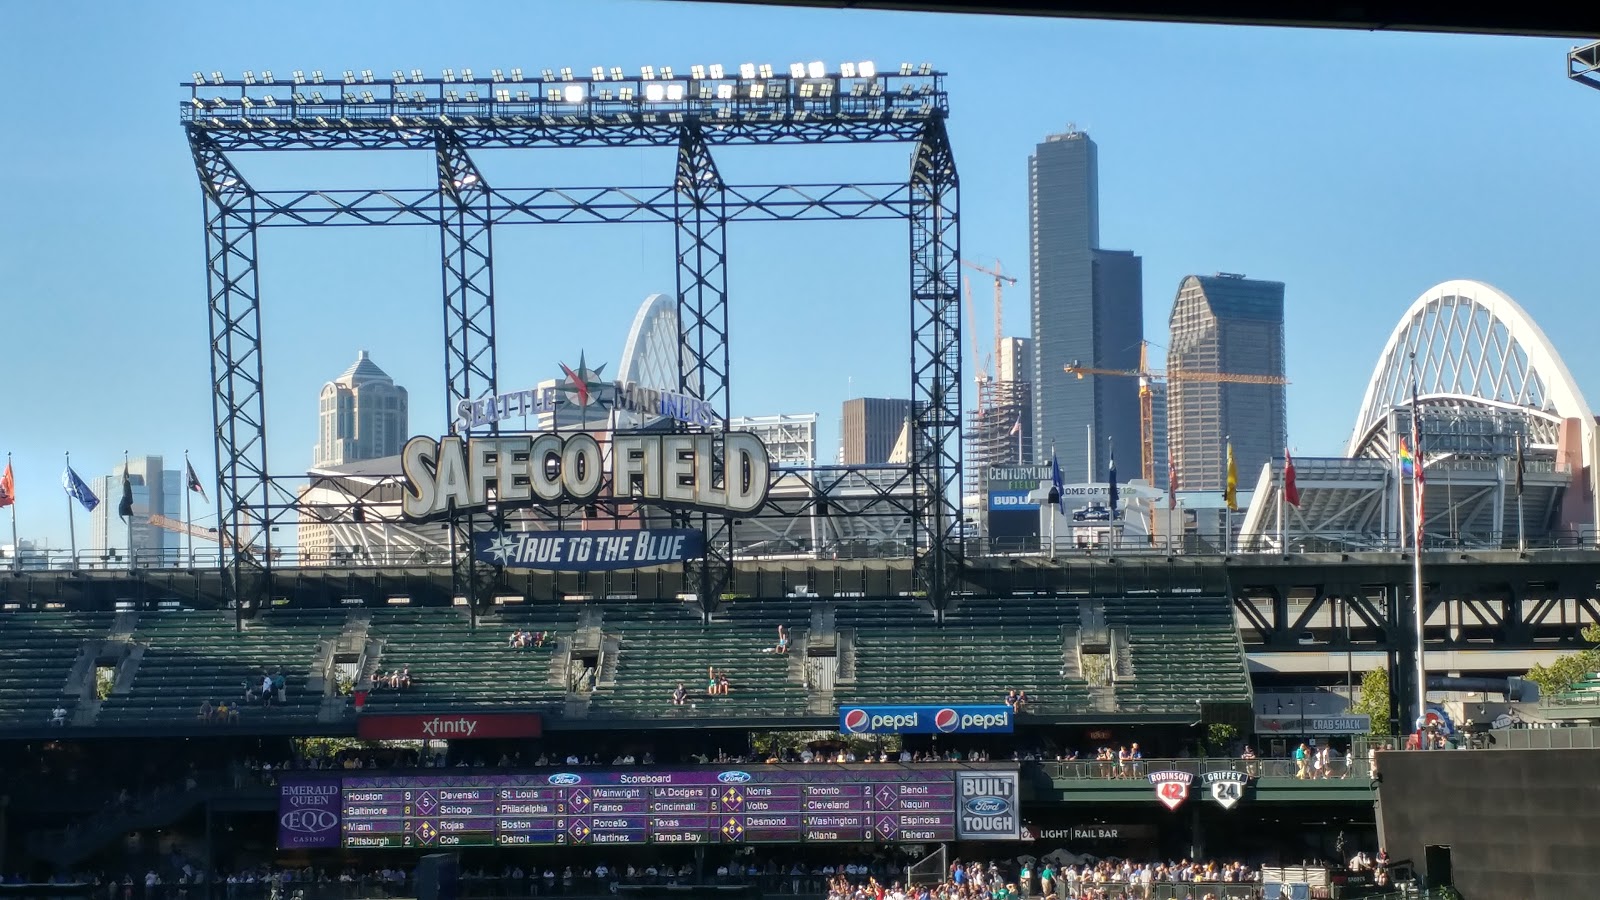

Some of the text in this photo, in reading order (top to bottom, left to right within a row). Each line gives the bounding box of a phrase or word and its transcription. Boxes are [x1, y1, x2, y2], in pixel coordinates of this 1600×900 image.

[456, 380, 713, 433] SEATTLE MARINERS
[402, 432, 770, 522] SAFECO FIELD
[1008, 481, 1036, 490] FIELD
[1088, 487, 1099, 495] OF
[993, 496, 1020, 505] BUD
[515, 531, 685, 562] TRUE TO THE BLUE
[871, 711, 918, 730] pepsi
[961, 711, 1008, 730] pepsi
[1312, 719, 1334, 730] CRAB
[1335, 719, 1360, 730] SHACK
[422, 717, 477, 736] xfinity
[620, 774, 672, 784] Scoreboard
[1151, 772, 1190, 782] ROBINSON
[1207, 772, 1242, 781] GRIFFEY
[282, 785, 338, 796] EMERALD
[746, 787, 772, 796] Norris
[808, 786, 871, 795] Toronto 2
[901, 785, 928, 794] Benoit
[963, 779, 1012, 796] BUILT
[1161, 783, 1184, 799] 42
[1217, 783, 1239, 800] 24
[348, 792, 411, 801] Houston 9
[501, 790, 513, 799] St.
[516, 790, 539, 799] Louis
[593, 788, 640, 798] Wainwright
[654, 788, 717, 798] LA Dodgers 0
[883, 792, 889, 801] 7
[290, 796, 329, 807] QUEEN
[423, 798, 429, 807] 5
[575, 796, 581, 805] 6
[808, 800, 870, 809] Cleveland 1
[901, 800, 930, 809] Naquin
[440, 805, 472, 815] Schoop
[501, 803, 564, 813] Philadelphia 3
[593, 803, 623, 812] Franco
[654, 802, 717, 811] Cincinnati 5
[746, 802, 769, 810] Votto
[974, 800, 1000, 811] Ford
[348, 806, 411, 815] Baltimore 8
[501, 820, 531, 829] Boston
[593, 819, 628, 828] Porcello
[654, 818, 680, 827] Texas
[746, 817, 787, 826] Desmond
[808, 816, 871, 826] Washington 1
[901, 815, 940, 825] Espinosa
[963, 817, 1013, 831] TOUGH
[348, 821, 411, 831] Miami 2
[440, 821, 465, 831] Rojas
[883, 823, 890, 832] 5
[423, 829, 429, 838] 6
[575, 827, 581, 836] 6
[808, 830, 871, 840] Atlanta 0
[901, 830, 935, 839] Teheran
[1040, 829, 1068, 839] LIGHT
[1074, 829, 1097, 838] RAIL
[1098, 829, 1118, 838] BAR
[347, 836, 411, 847] Pittsburgh 2
[440, 835, 460, 844] Cole
[501, 834, 564, 843] Detroit 2
[593, 833, 630, 842] Martinez
[654, 832, 702, 842] Tampa Bay
